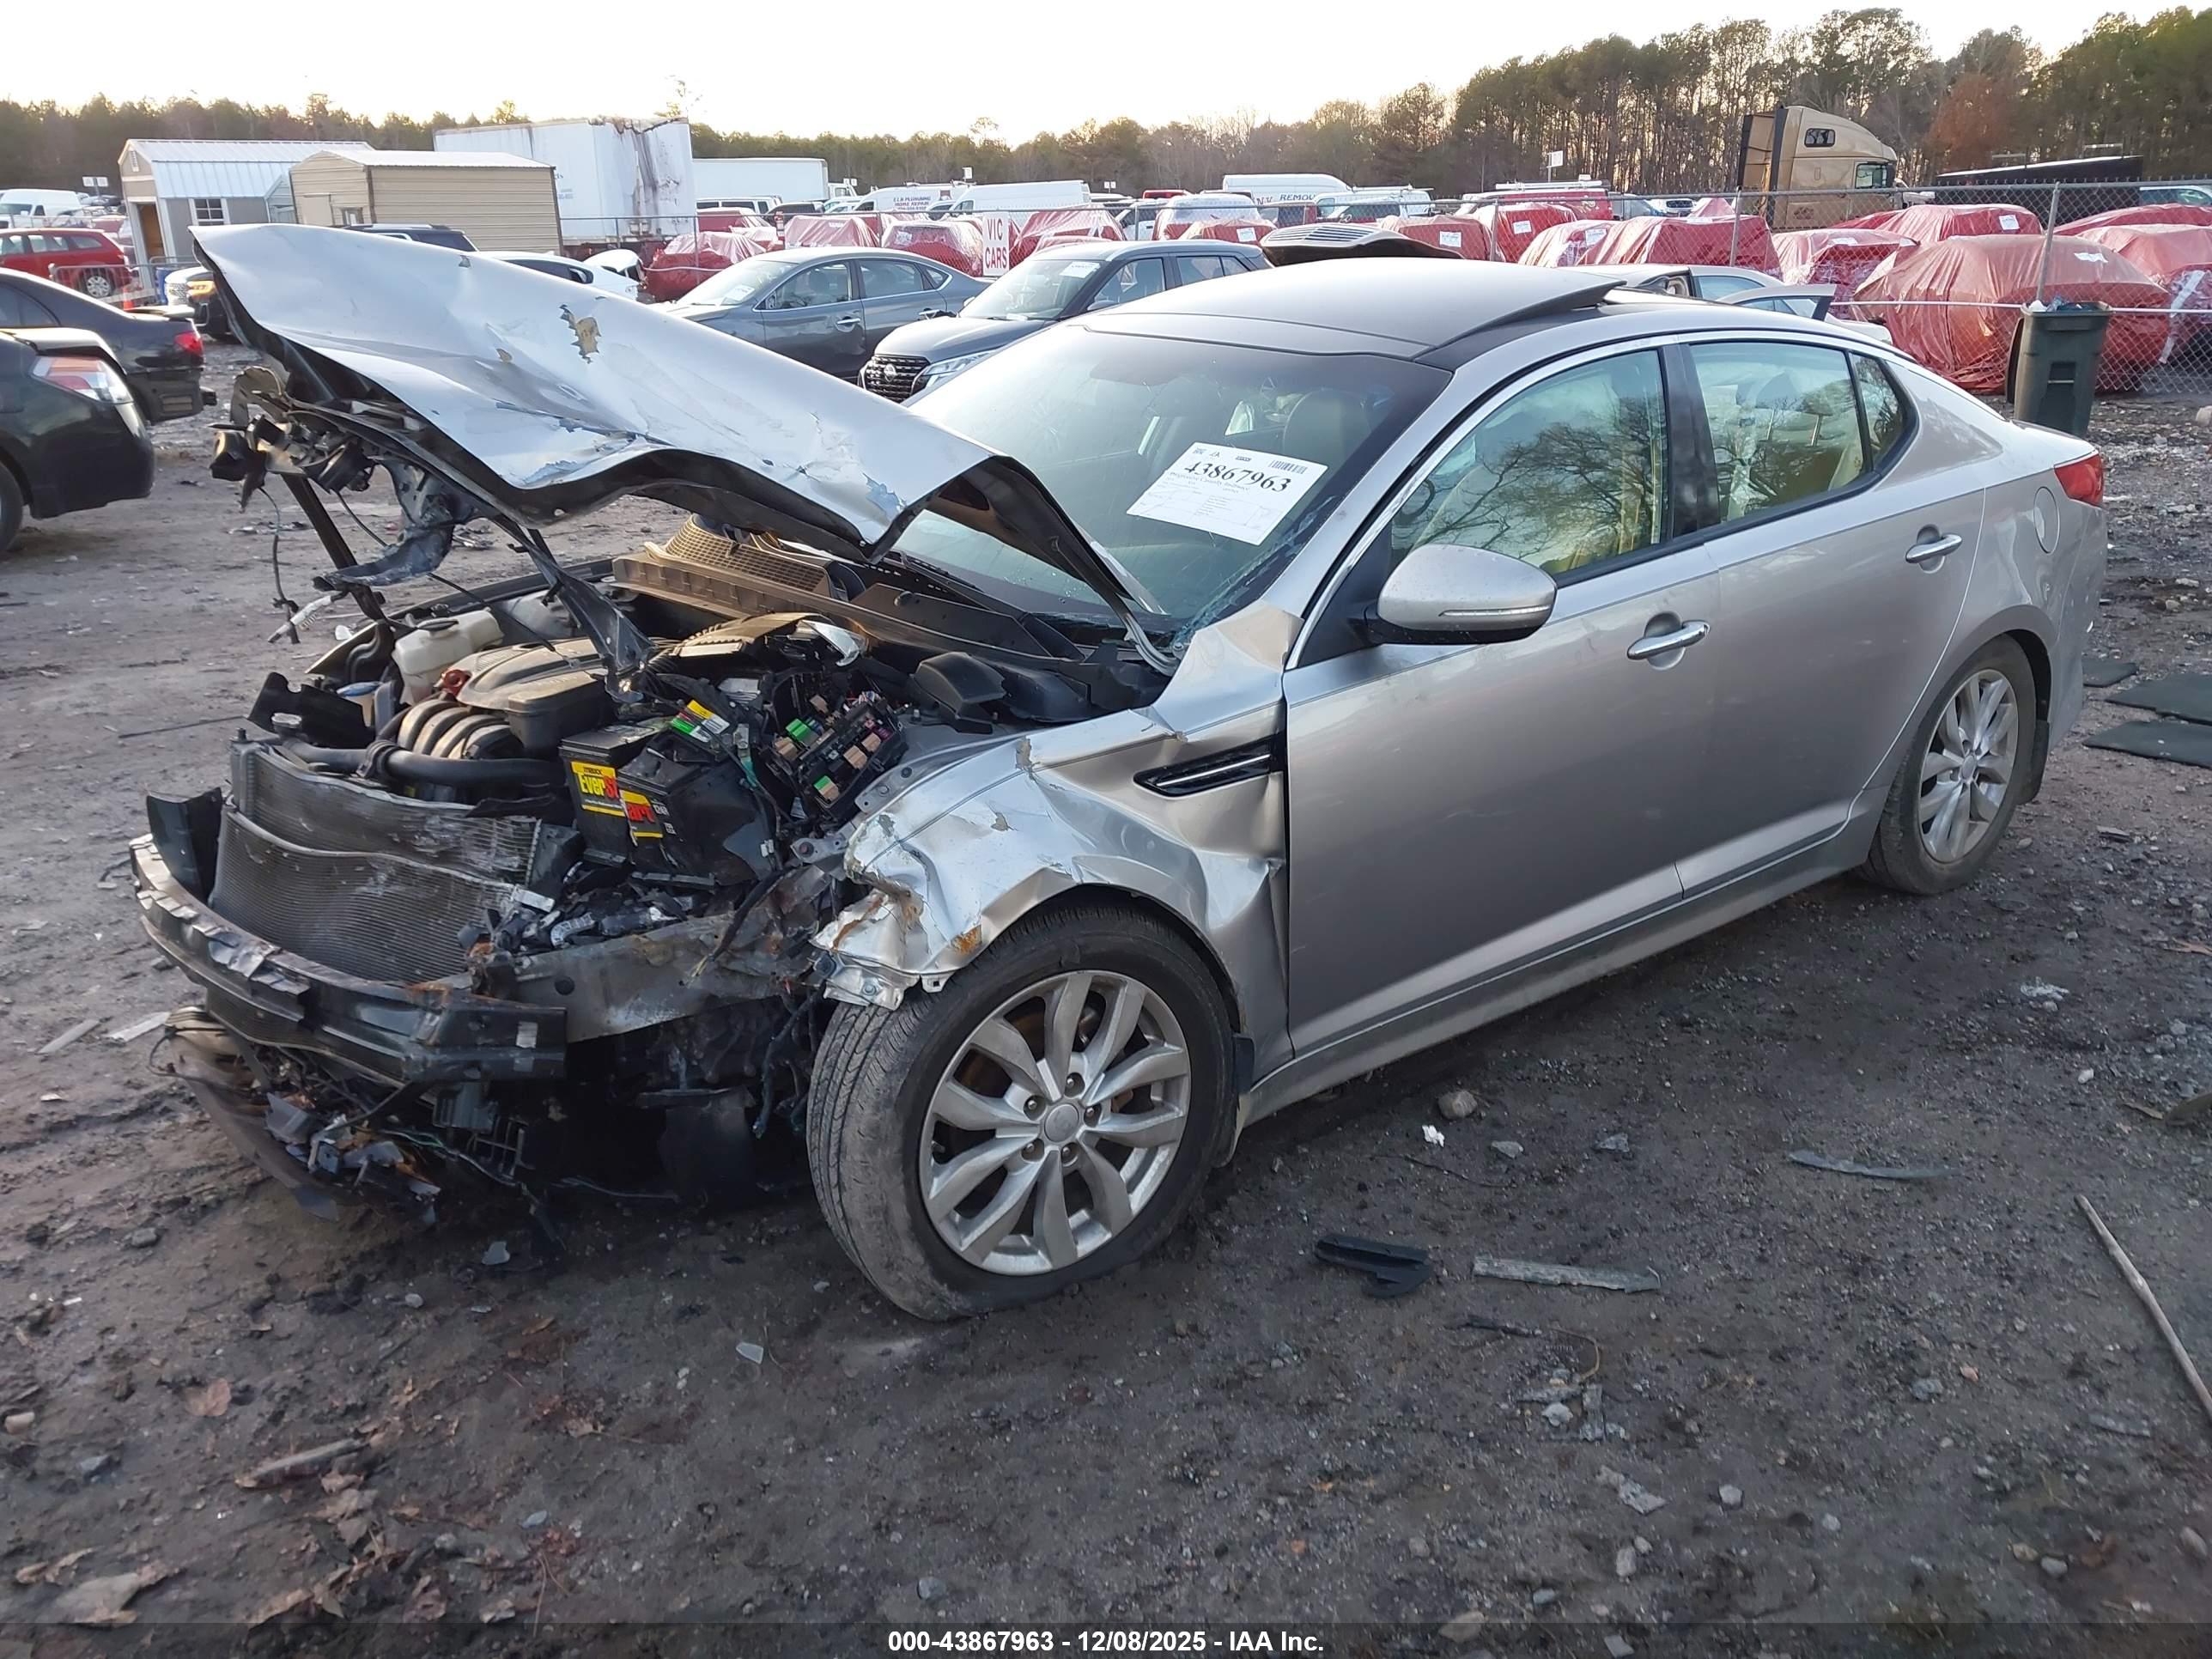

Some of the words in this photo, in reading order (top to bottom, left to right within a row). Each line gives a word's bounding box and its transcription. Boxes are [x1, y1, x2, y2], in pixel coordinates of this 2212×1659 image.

[988, 218, 1003, 241] VIC
[985, 246, 1007, 269] CARS
[1184, 461, 1291, 492] 43867963
